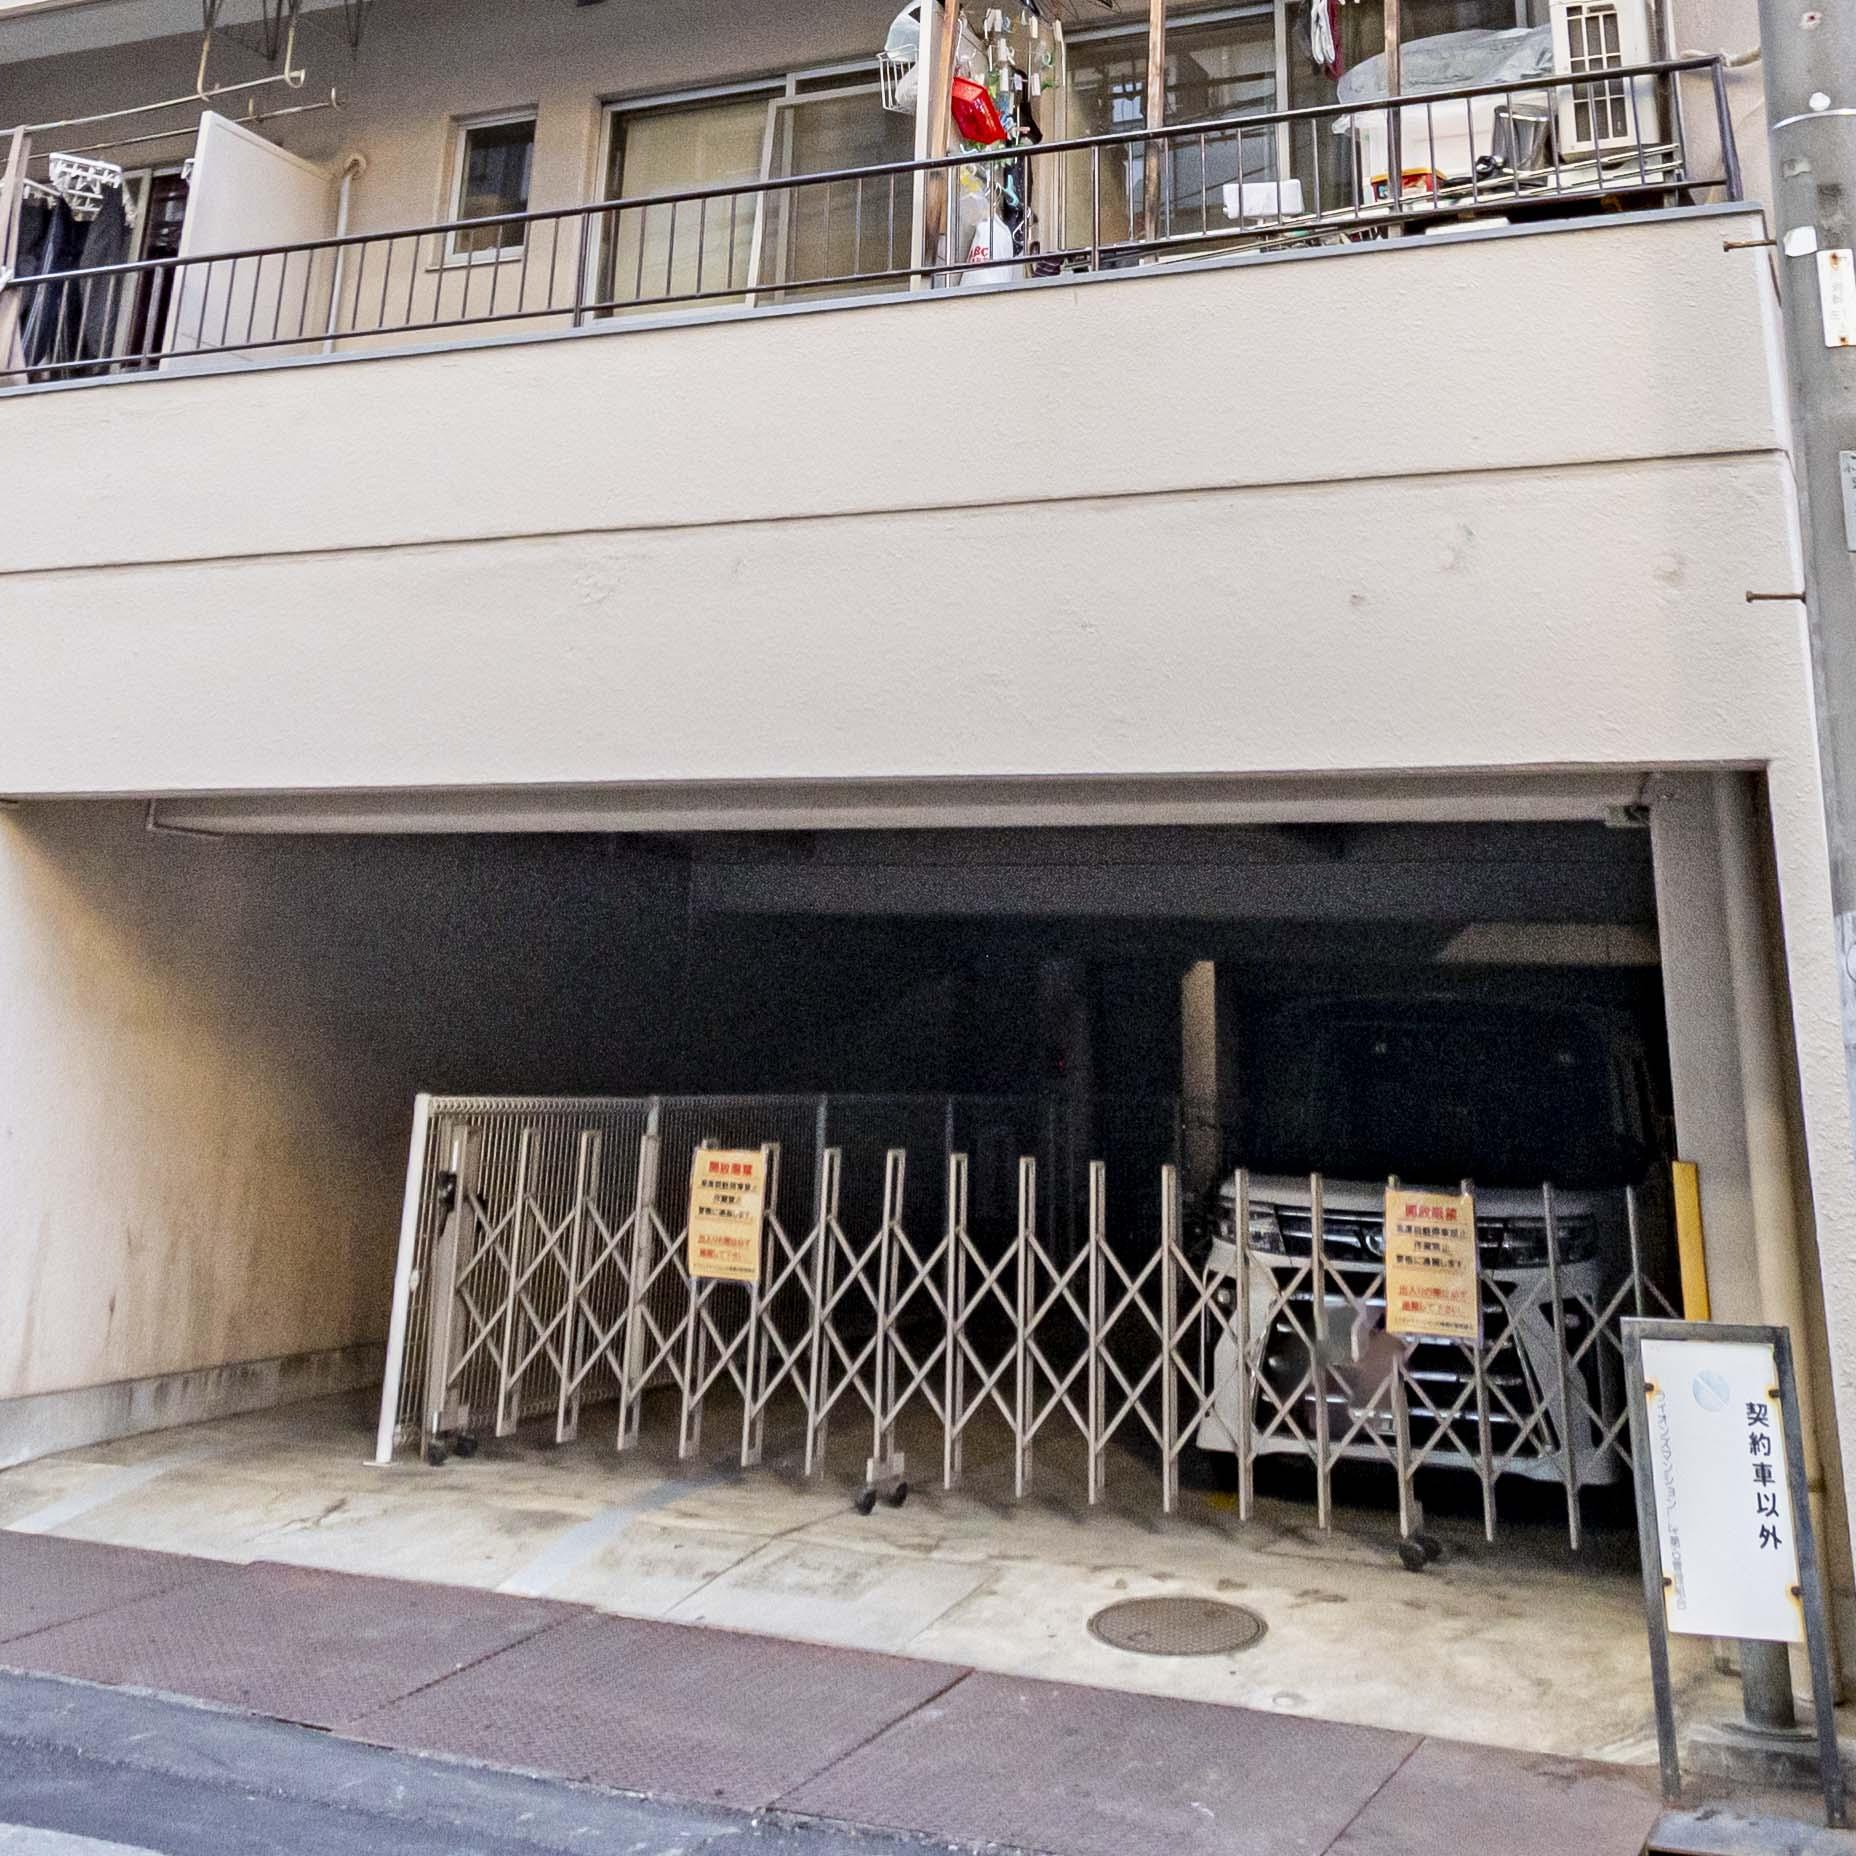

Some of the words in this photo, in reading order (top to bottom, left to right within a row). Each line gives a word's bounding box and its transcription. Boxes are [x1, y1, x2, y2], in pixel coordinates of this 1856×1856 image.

[1745, 1401, 1783, 1551] 契約車以外
